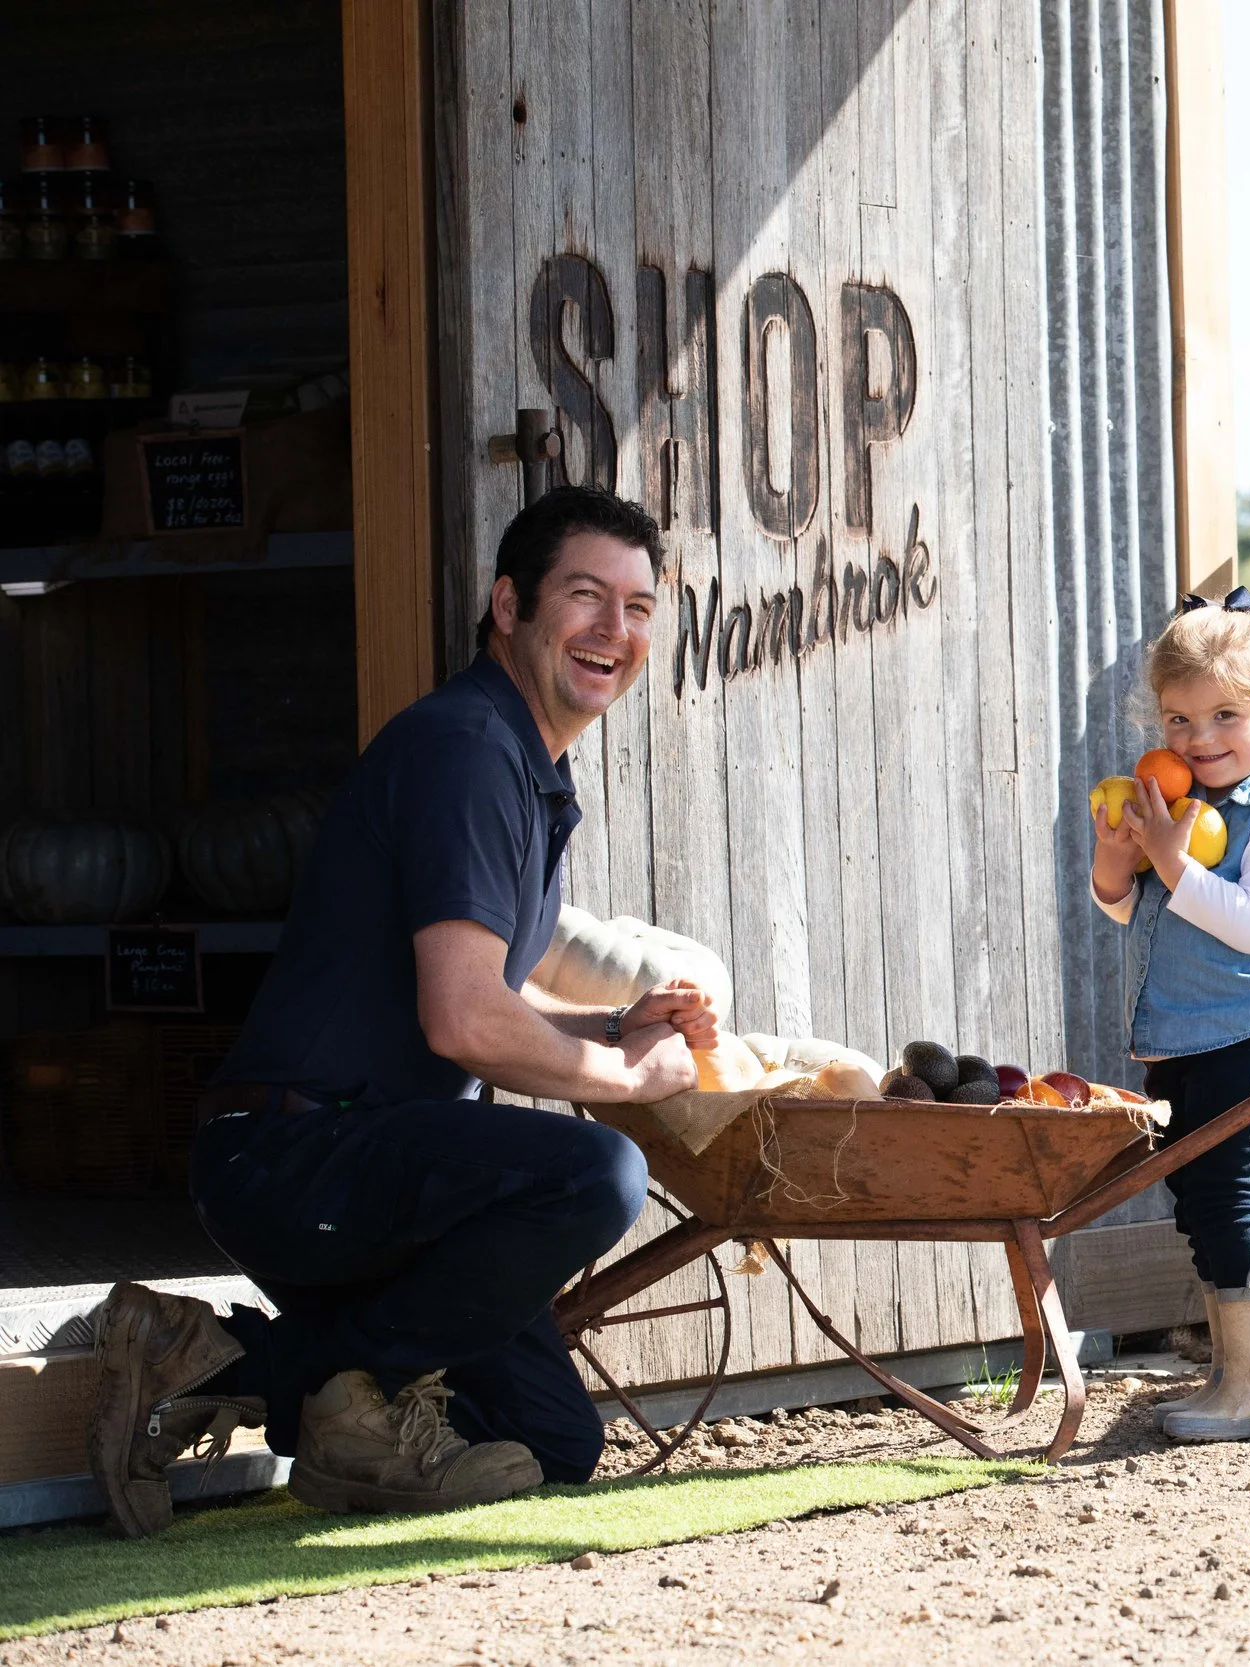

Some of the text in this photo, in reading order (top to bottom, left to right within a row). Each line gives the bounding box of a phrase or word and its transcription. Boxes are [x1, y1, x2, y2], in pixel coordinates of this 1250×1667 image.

[155, 453, 193, 467] Local
[530, 253, 917, 541] SHOP
[674, 502, 937, 700] Nambrok
